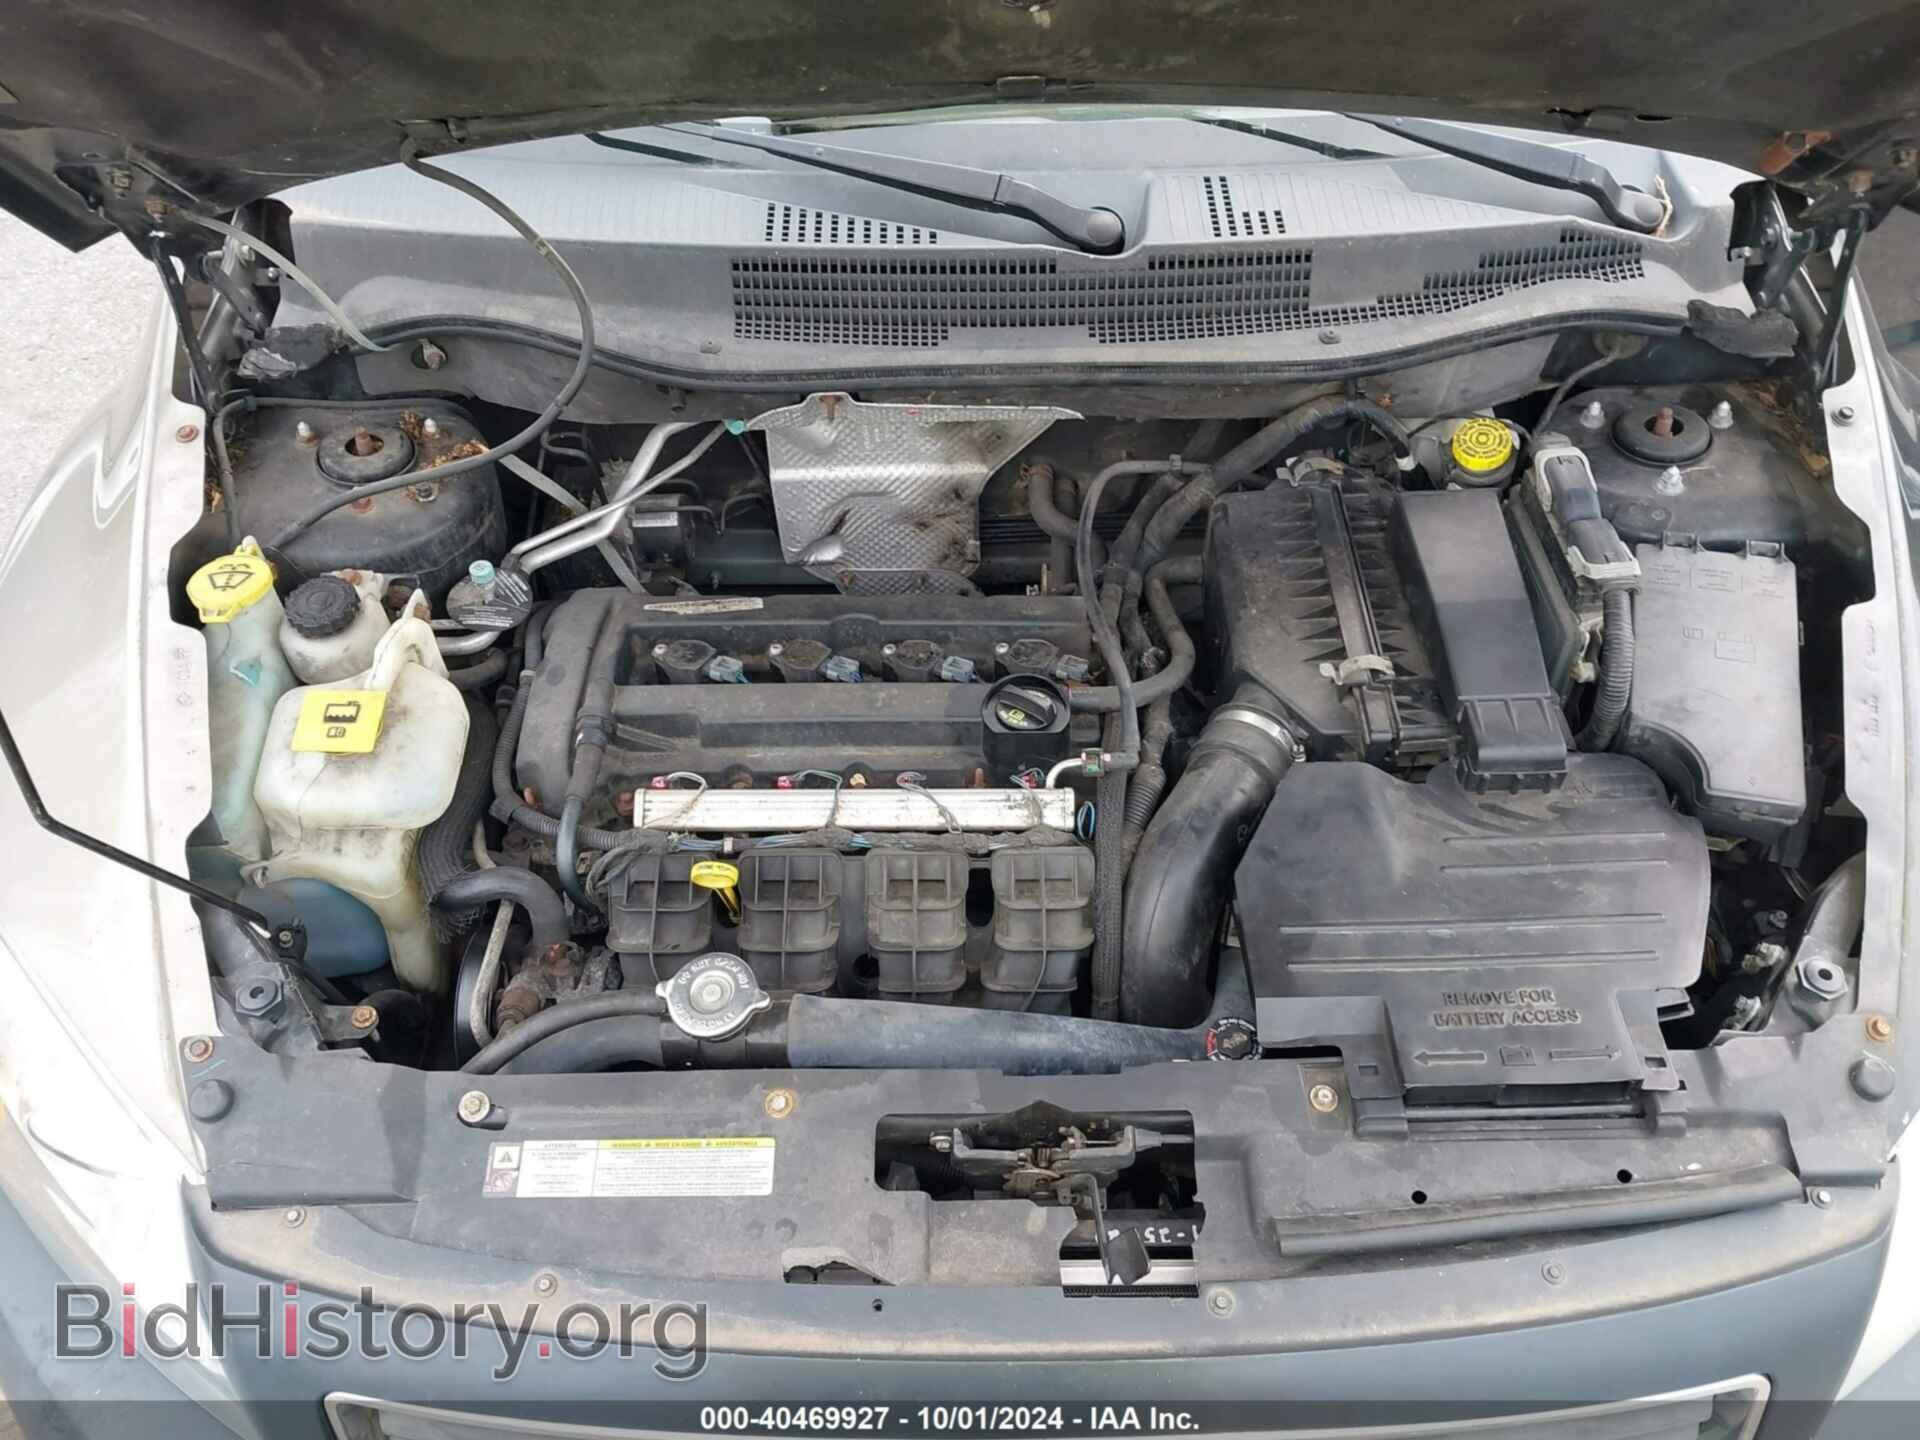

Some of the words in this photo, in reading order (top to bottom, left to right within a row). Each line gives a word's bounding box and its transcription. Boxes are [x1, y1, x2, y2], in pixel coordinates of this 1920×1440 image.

[1442, 991, 1516, 1006] REMOVE
[1518, 988, 1556, 1004] FOR
[1433, 1012, 1505, 1028] BATTERY
[1511, 1009, 1581, 1025] ACCESS
